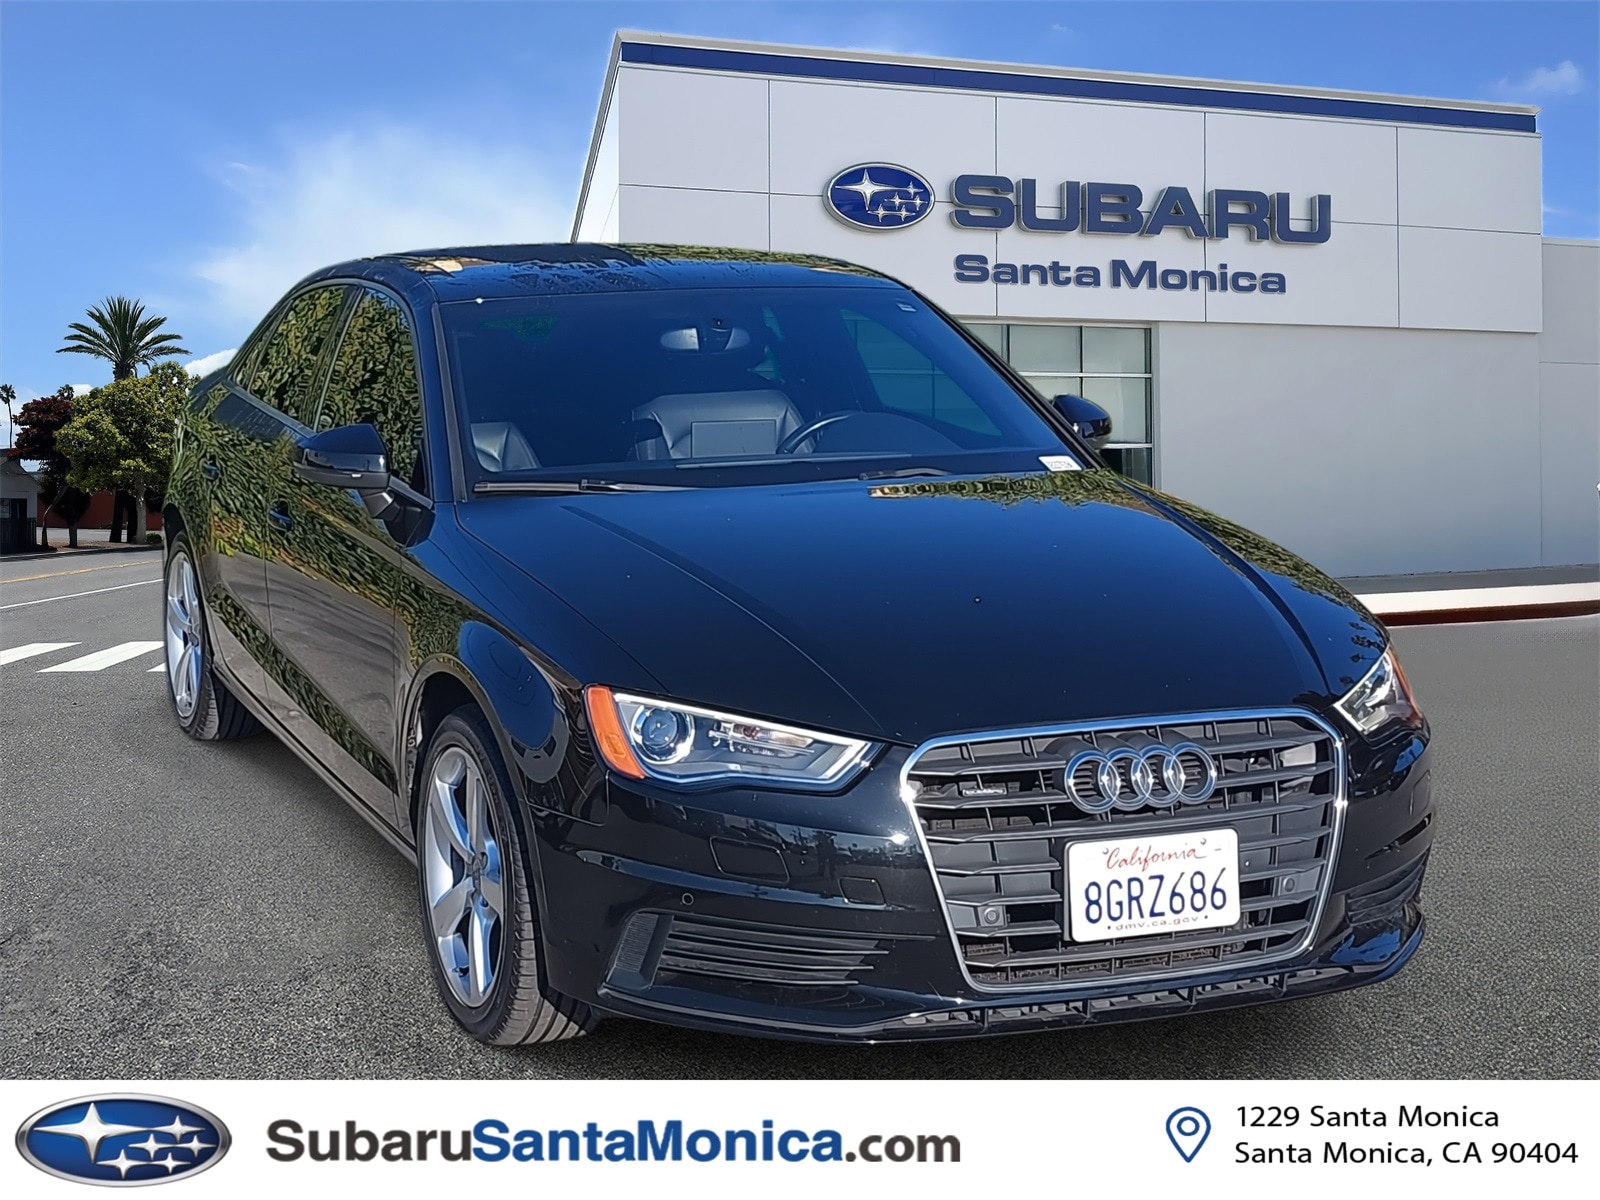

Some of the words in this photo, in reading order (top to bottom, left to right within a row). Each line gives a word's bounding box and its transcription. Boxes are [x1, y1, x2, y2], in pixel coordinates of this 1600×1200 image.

[949, 174, 1332, 245] SUBARU
[954, 254, 1101, 288] Santa
[1112, 259, 1287, 294] Monica
[1106, 845, 1207, 872] California
[1084, 867, 1227, 924] 8GRZ686
[1115, 915, 1199, 931] dmv.ca.gov
